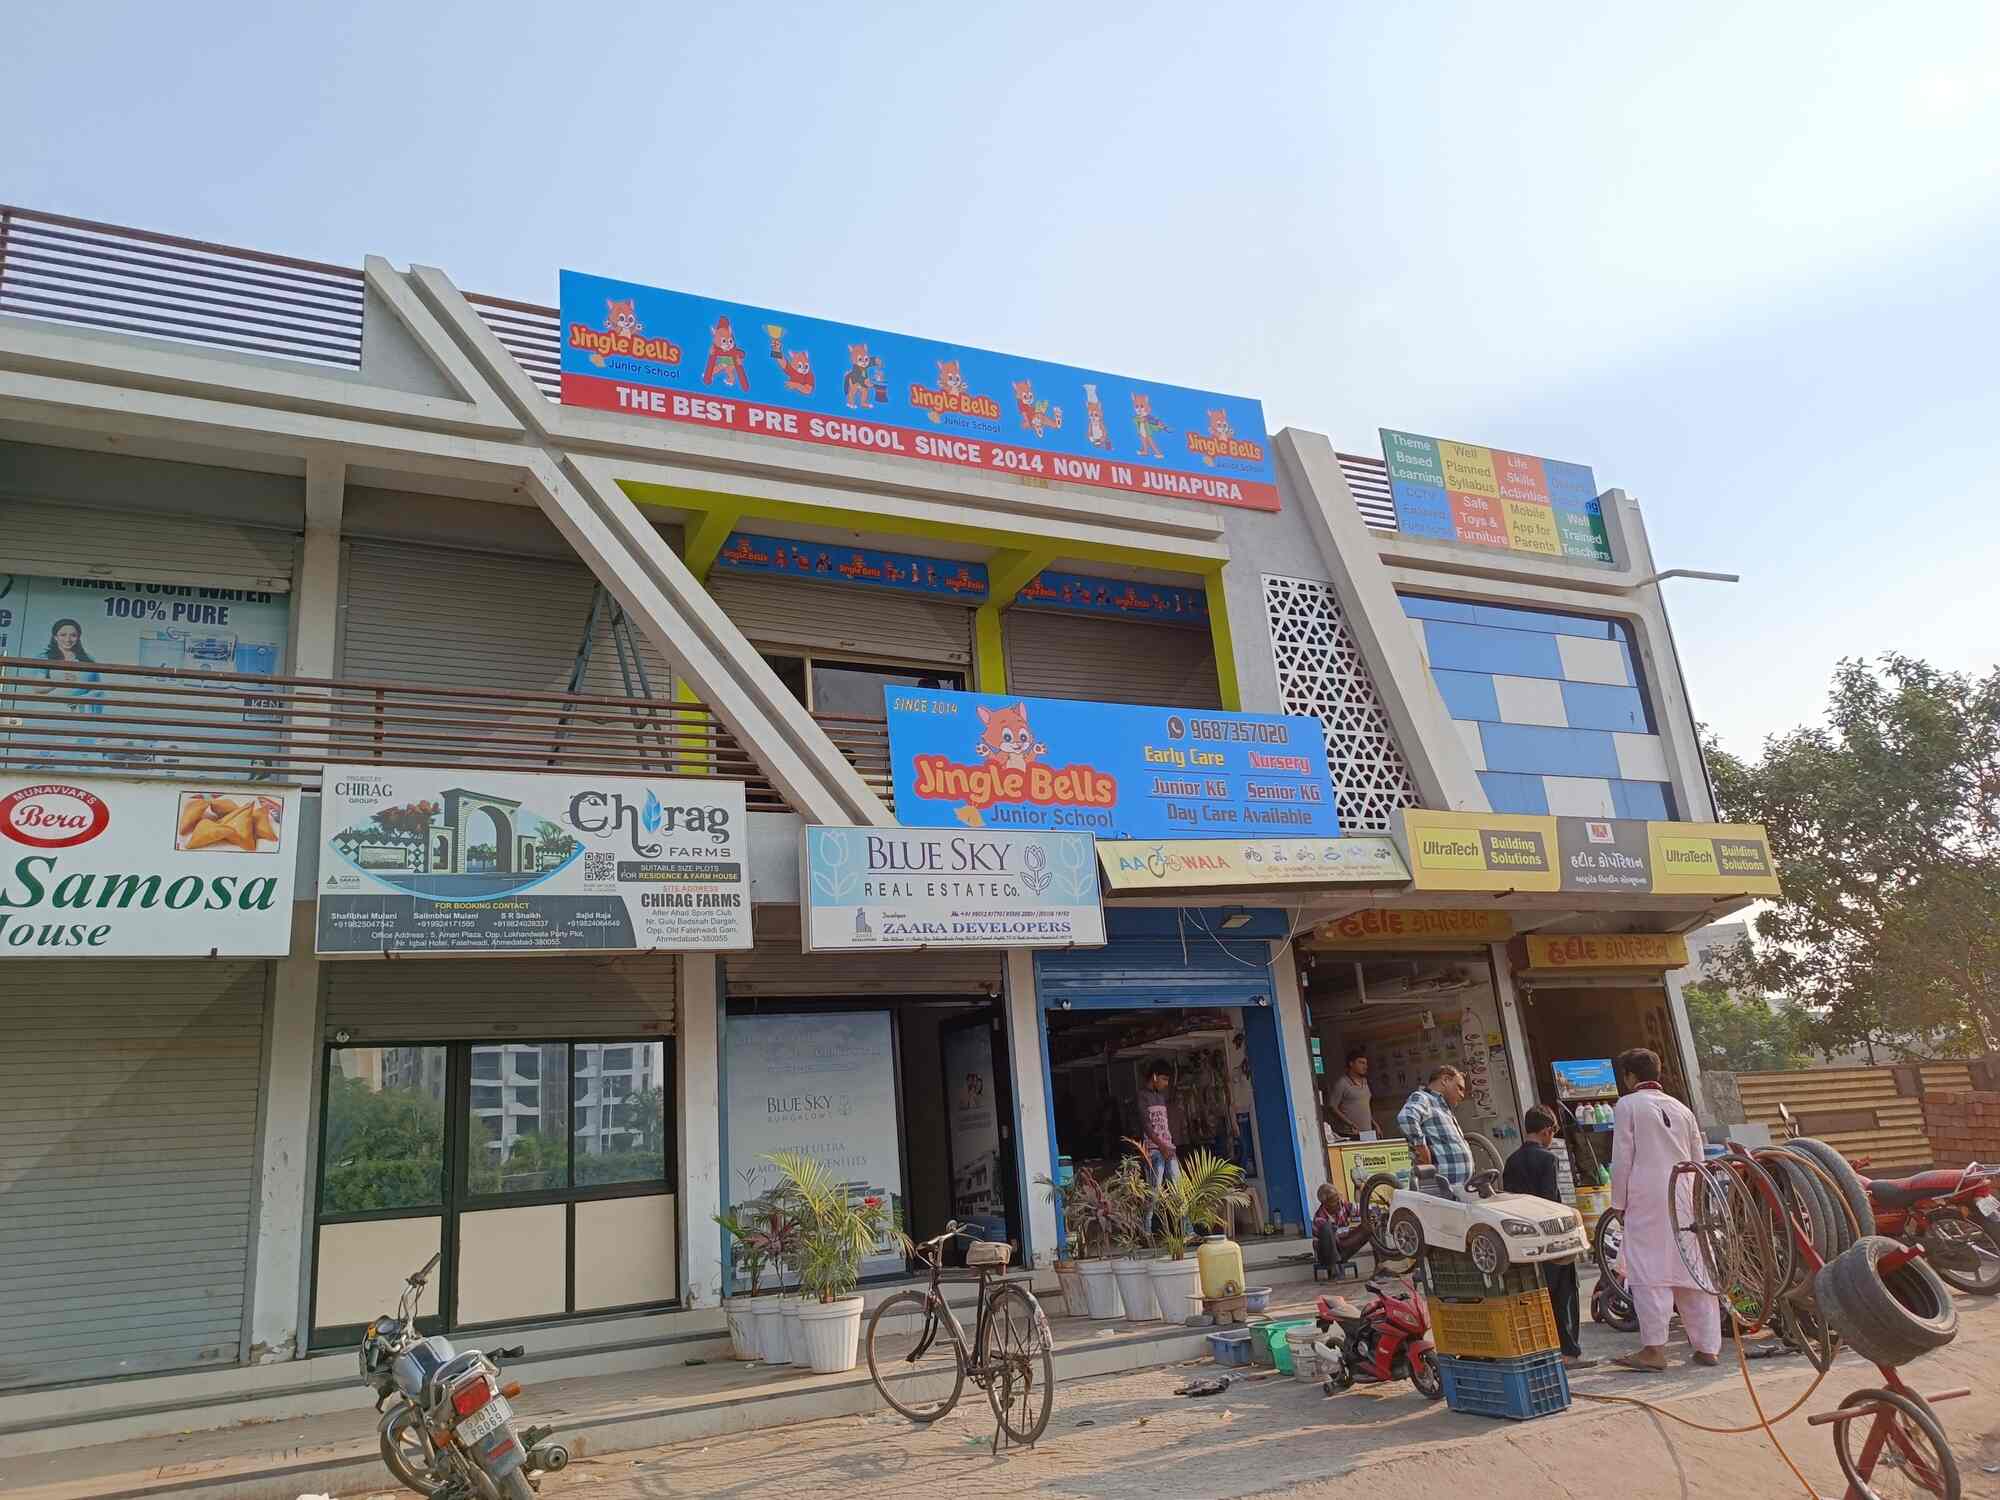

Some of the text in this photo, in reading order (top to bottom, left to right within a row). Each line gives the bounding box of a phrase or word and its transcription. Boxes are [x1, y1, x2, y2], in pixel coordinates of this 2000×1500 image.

[571, 326, 680, 361] Jingle Bells
[608, 358, 680, 378] Junior School
[911, 386, 999, 417] Jingle Bells
[616, 385, 1243, 501] THE BEST PRE SCHOOL SINCE 2014 NOW IN JUHAPURA
[1188, 432, 1263, 459] Jingle Bells
[1392, 433, 1431, 450] Theme
[1396, 451, 1433, 467] Based
[1454, 446, 1477, 458] Well
[1446, 460, 1492, 477] Planned
[1391, 468, 1443, 487] Learning
[1448, 475, 1495, 493] Syllabus
[1463, 495, 1489, 510] Safe
[1500, 487, 1550, 504] Activities
[1460, 511, 1486, 528] Toys
[1488, 517, 1498, 529] &
[1510, 503, 1545, 520] Mobile
[1567, 512, 1589, 527] Well
[1456, 527, 1509, 545] Furniture
[1512, 520, 1552, 536] App for
[1514, 535, 1555, 552] Parents
[103, 596, 229, 625] 100% PURE
[1189, 719, 1289, 744] 9687357020
[1144, 745, 1225, 768] Early Care
[1248, 751, 1311, 774] Nursery
[335, 782, 393, 797] CHIRAG
[918, 760, 1113, 806] Jingle Bells
[1151, 776, 1227, 798] Junior KG
[1247, 780, 1321, 801] Senior KG
[15, 804, 88, 829] Bera
[990, 803, 1114, 828] Junior School
[1167, 803, 1313, 826] Day Care Available
[1423, 840, 1479, 857] UltraTech
[1491, 836, 1536, 851] Building
[1720, 844, 1758, 858] Building
[669, 847, 732, 858] FARMS
[866, 836, 1012, 871] BLUE SKY
[1491, 851, 1542, 866] Solutions
[1666, 848, 1712, 864] UltraTech
[1181, 855, 1232, 870] WALA
[1721, 857, 1765, 871] Solutions
[0, 855, 279, 911] Samosa
[864, 882, 1020, 897] REAL ESTATE Co.
[435, 902, 529, 910] FOR BOOKING CONTACT
[641, 893, 741, 908] CHIRAG FARMS
[883, 921, 1072, 934] ZAARA DEVELOPERS
[767, 1094, 833, 1113] BLUE SKY
